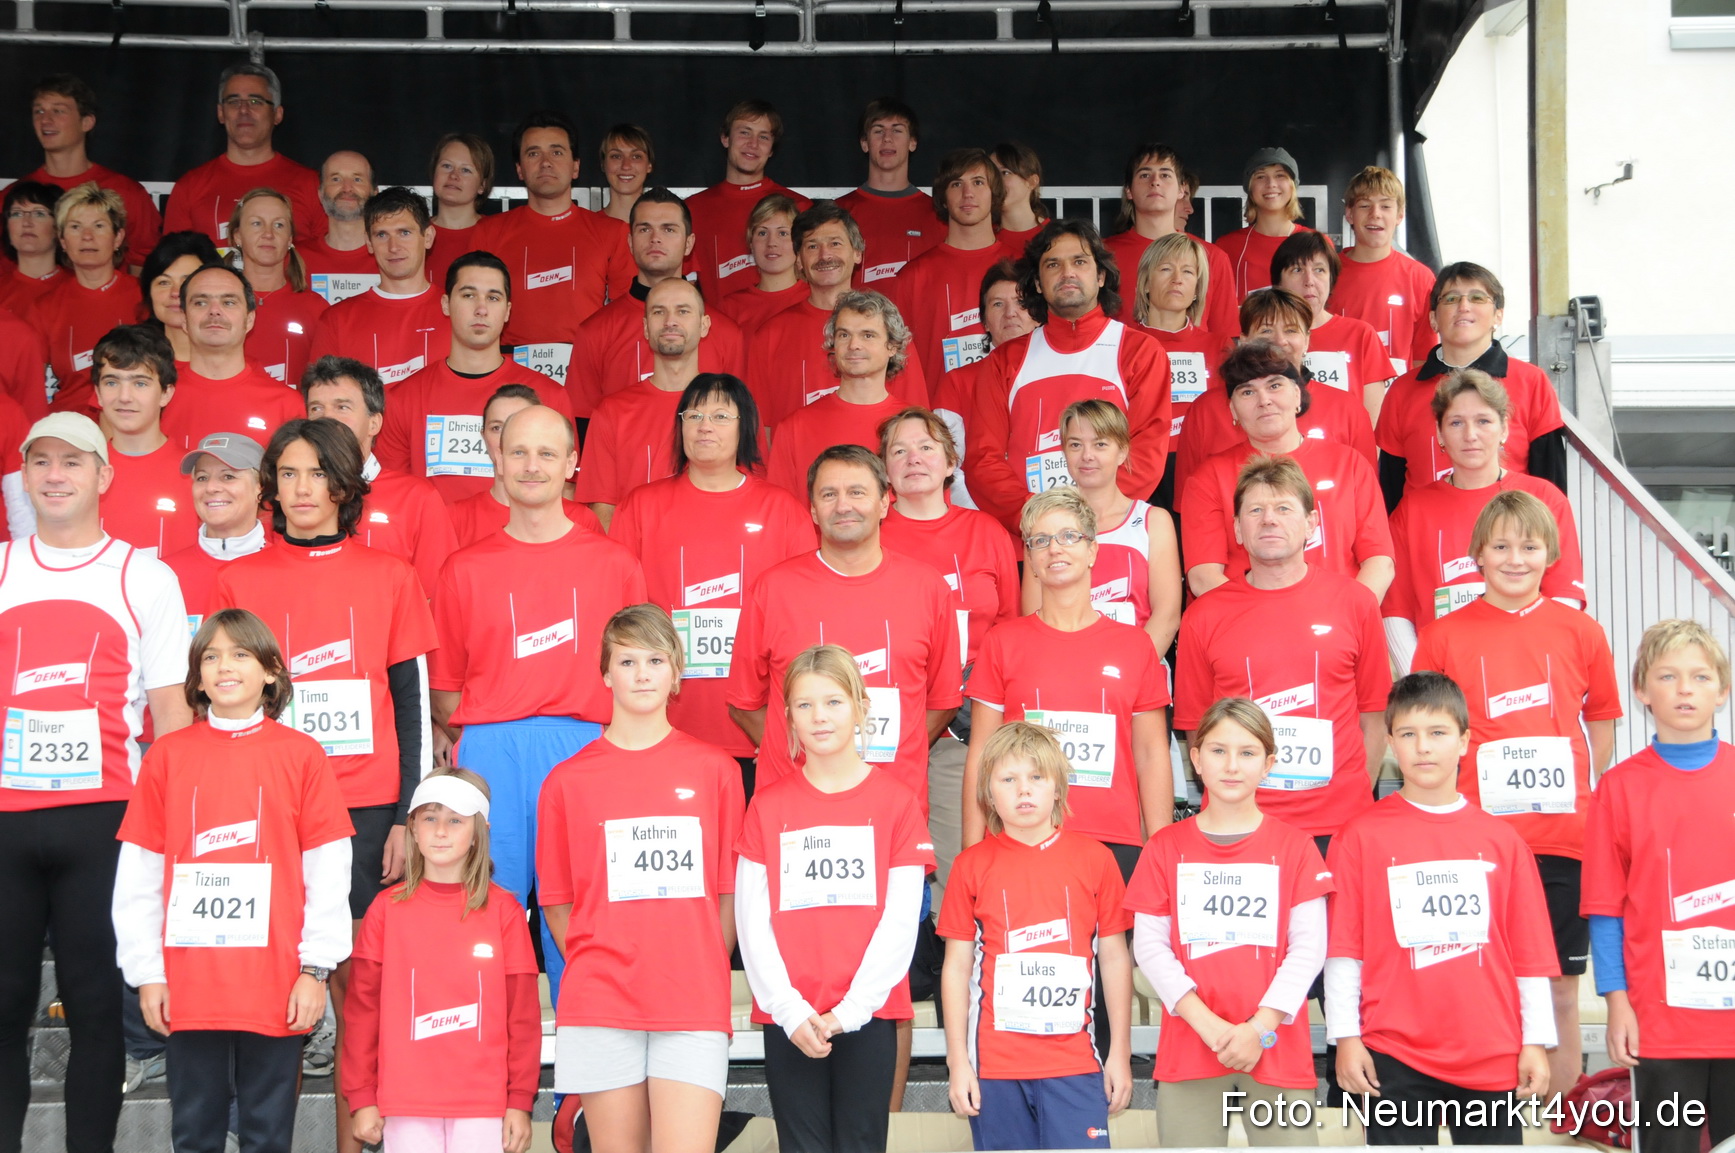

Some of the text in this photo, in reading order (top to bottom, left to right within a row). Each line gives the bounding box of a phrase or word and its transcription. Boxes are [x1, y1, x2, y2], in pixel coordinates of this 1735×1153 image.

[540, 273, 559, 283] DEHN
[876, 267, 895, 277] DEHN
[332, 279, 361, 291] Walter
[532, 349, 553, 359] Adolf
[390, 367, 411, 378] DEHN
[447, 438, 489, 455] 234
[700, 583, 725, 597] DEHN
[695, 615, 723, 629] Doris
[532, 631, 557, 648] DEHN
[308, 649, 334, 667] DEHN
[34, 670, 67, 684] DEHN
[300, 689, 328, 704] Timo
[1270, 694, 1297, 710] DEHN
[1506, 693, 1532, 707] DEHN
[29, 719, 64, 734] Oliver
[303, 710, 361, 734] 5031
[1047, 718, 1089, 734] Andrea
[30, 741, 89, 763] 2332
[1502, 745, 1537, 760] Peter
[1506, 767, 1566, 790] 4030
[208, 831, 238, 846] DEHN
[632, 824, 677, 842] Kathrin
[803, 836, 832, 852] Alina
[634, 849, 694, 873] 4034
[805, 857, 866, 881] 4033
[195, 870, 230, 888] Tizian
[1203, 870, 1242, 887] Selina
[1415, 870, 1459, 887] Dennis
[192, 896, 256, 919] 4021
[1203, 894, 1268, 920] 4022
[1421, 893, 1482, 918] 4023
[1693, 892, 1722, 909] DEHN
[1026, 927, 1053, 942] DEHN
[1020, 960, 1056, 977] Lukas
[1022, 985, 1081, 1008] 4025
[431, 1013, 461, 1030] DEHN
